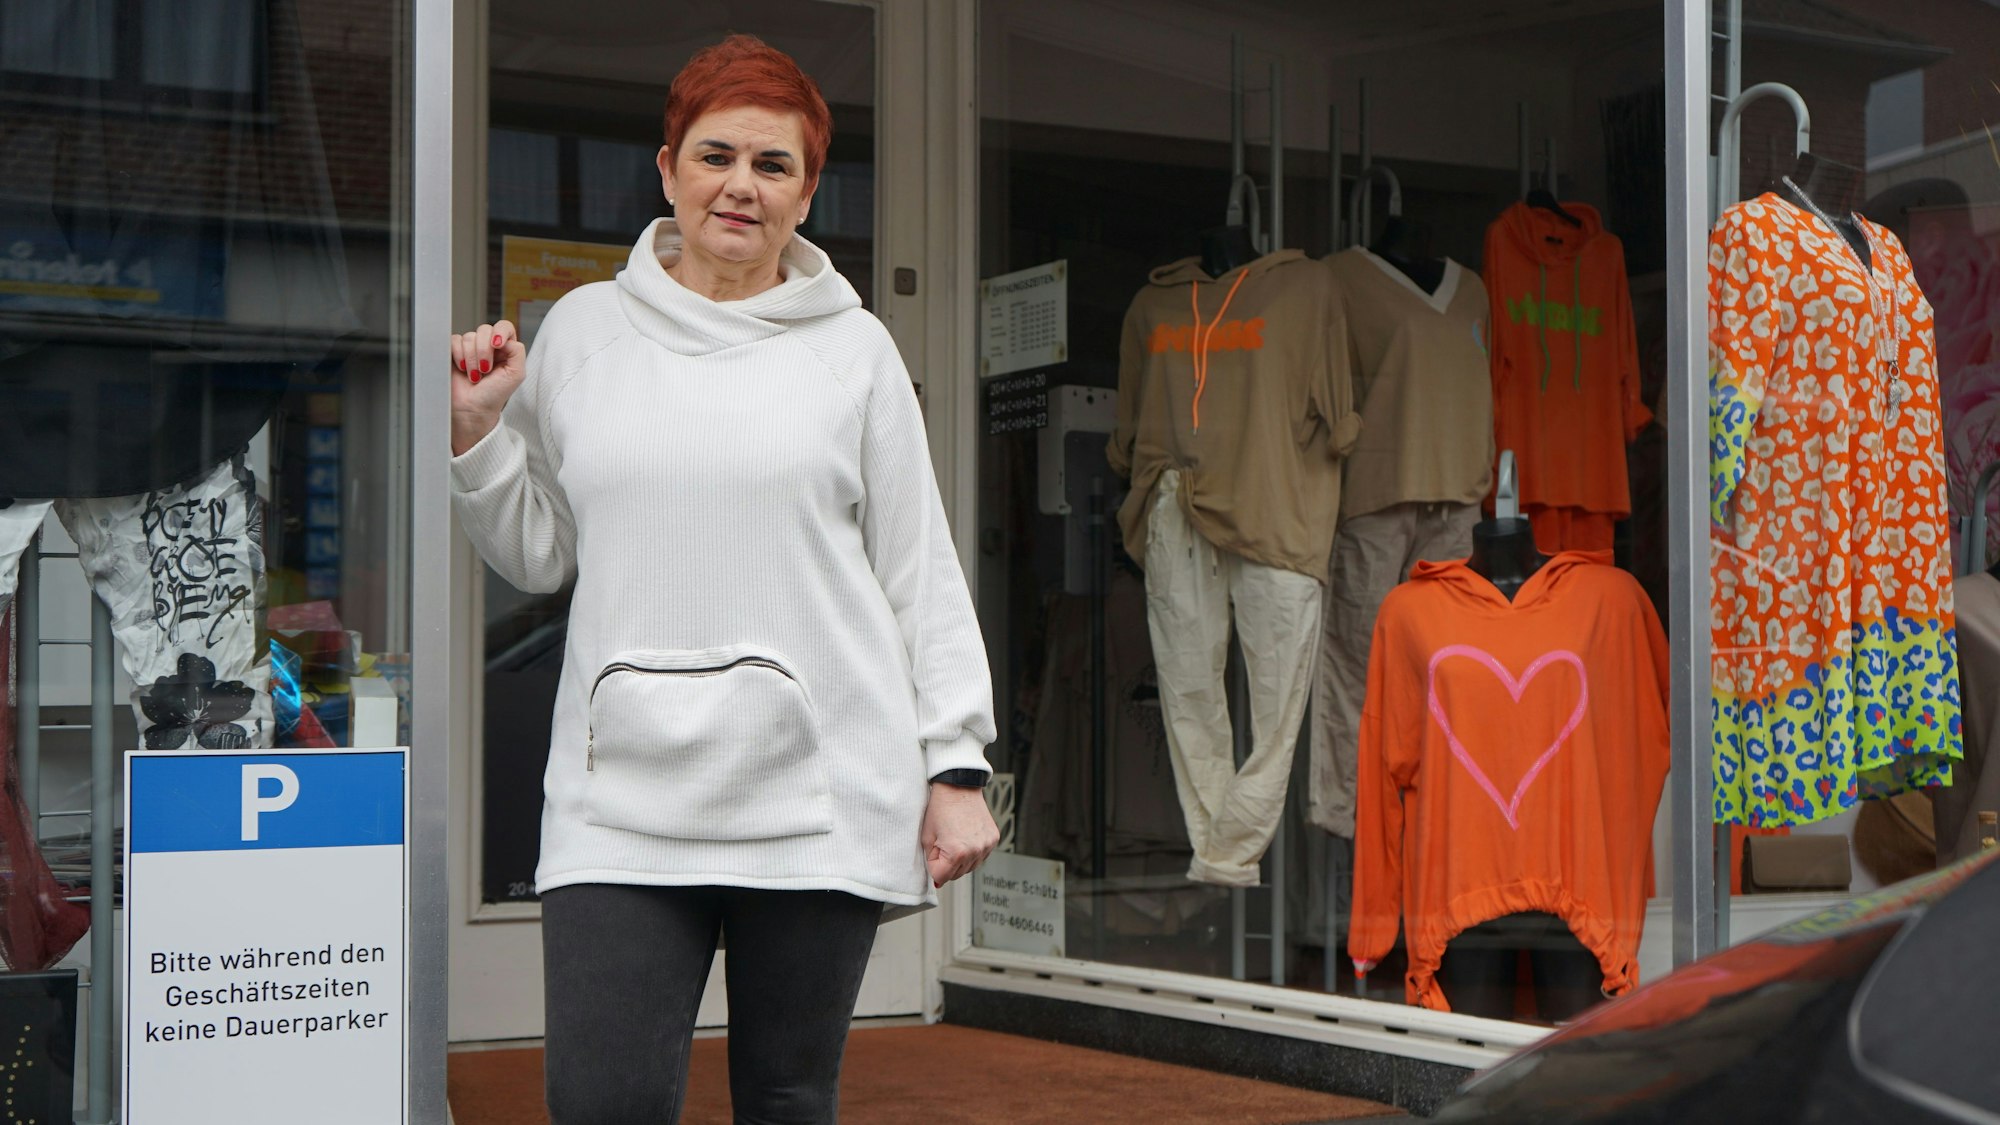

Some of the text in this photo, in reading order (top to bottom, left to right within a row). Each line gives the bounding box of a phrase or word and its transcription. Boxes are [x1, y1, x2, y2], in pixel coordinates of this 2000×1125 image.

[241, 763, 299, 841] P
[1022, 880, 1059, 900] Schütz
[150, 943, 385, 974] Bitte während den
[165, 978, 370, 1007] Geschäftszeiten
[145, 1009, 389, 1043] keine Dauerparker
